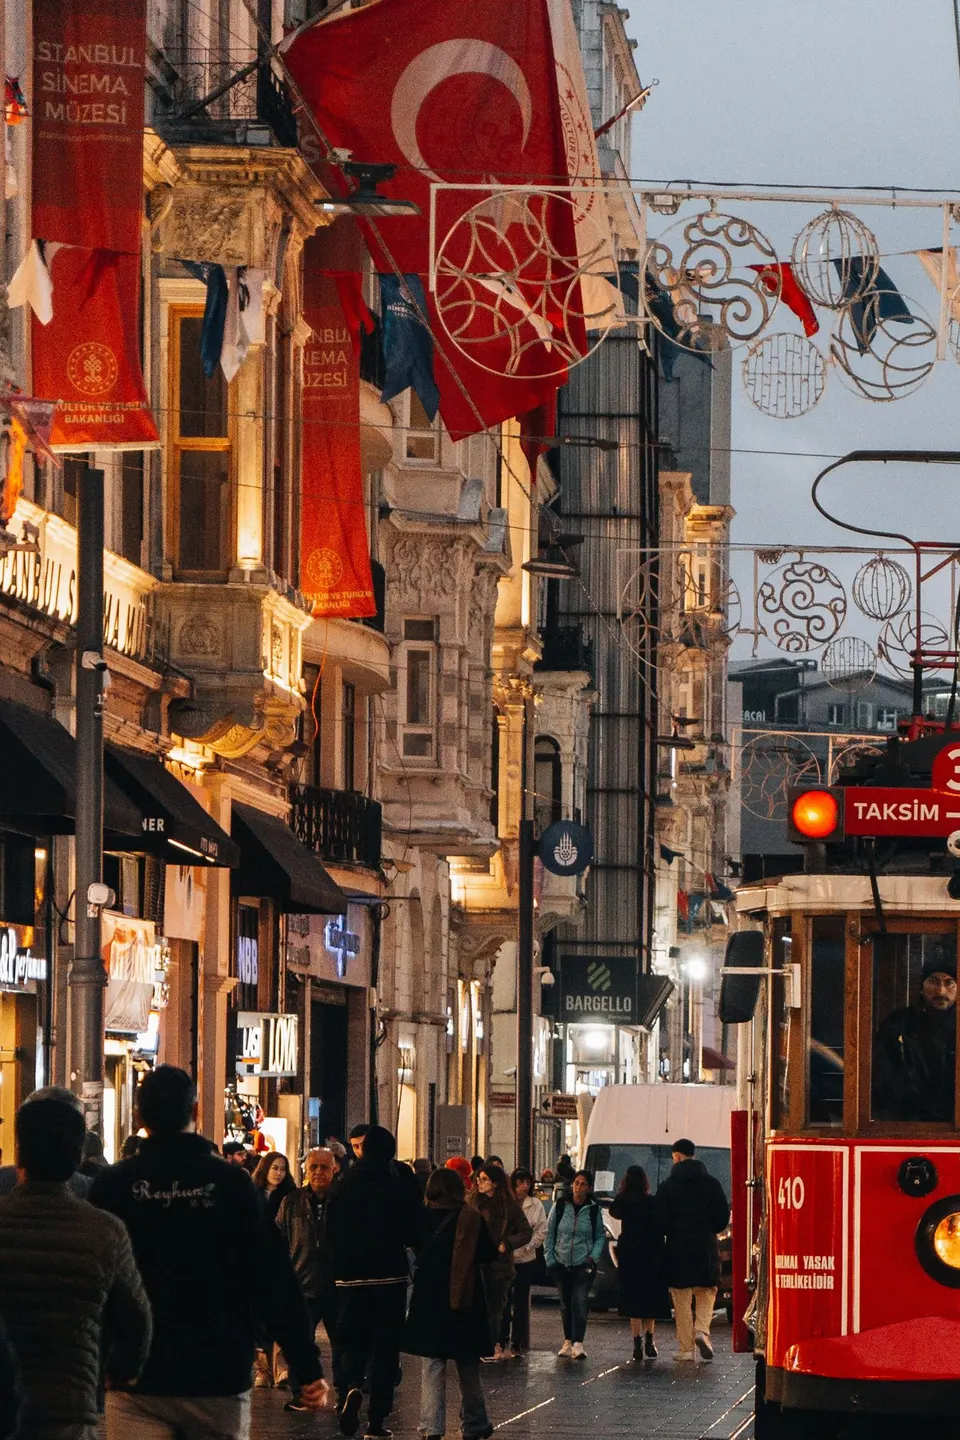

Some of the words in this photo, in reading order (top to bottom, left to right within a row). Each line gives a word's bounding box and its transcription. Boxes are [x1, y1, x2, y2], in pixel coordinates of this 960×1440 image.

[38, 41, 142, 67] STANBUL
[42, 68, 131, 96] SİNEMA
[45, 101, 127, 125] MÜZESİ
[853, 799, 939, 822] TAKSİM
[565, 994, 632, 1012] BARGELLO
[777, 1176, 805, 1210] 410
[803, 1255, 836, 1270] YASAK
